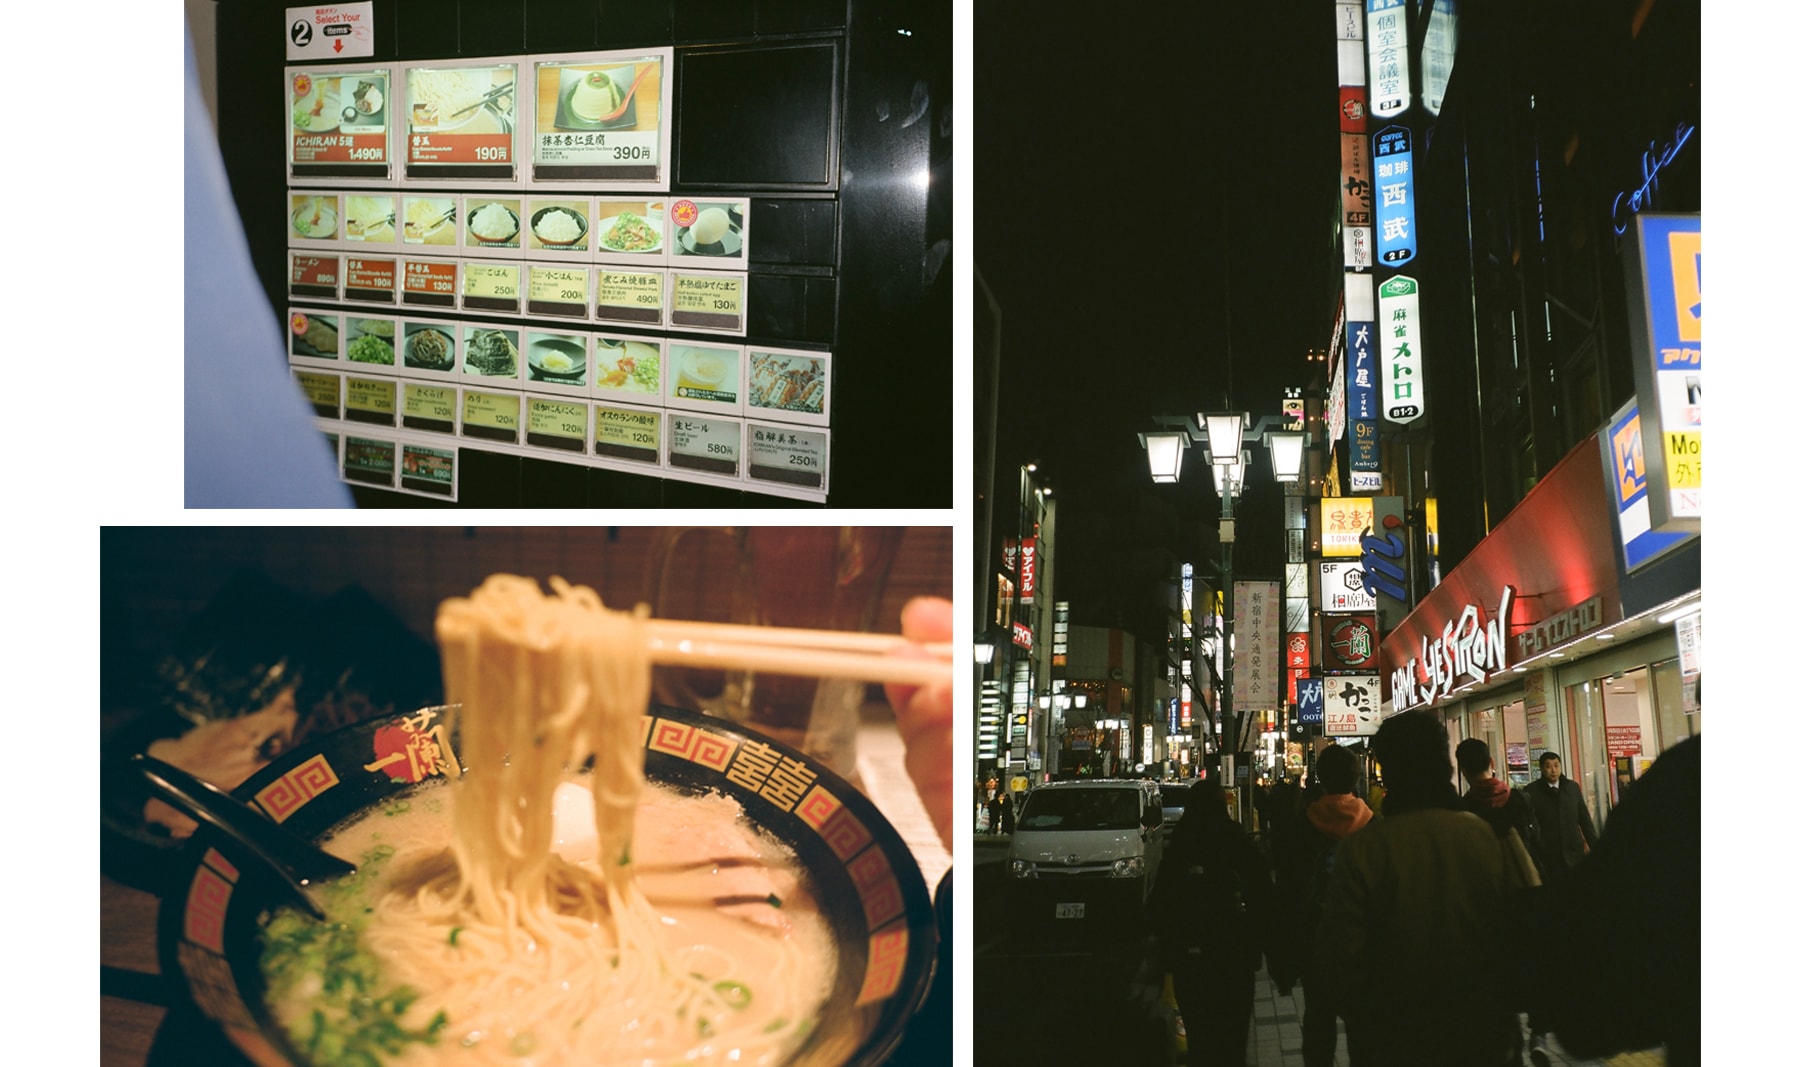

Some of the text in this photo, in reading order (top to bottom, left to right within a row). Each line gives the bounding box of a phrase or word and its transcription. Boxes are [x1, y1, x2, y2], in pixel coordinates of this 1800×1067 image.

[316, 14, 361, 24] Select Your
[295, 21, 309, 44] 2
[327, 26, 348, 35] items
[1377, 14, 1400, 96] 個室会議室
[296, 136, 337, 146] ICHIRAN
[542, 134, 606, 146] 抹茶杏仁豆腐
[348, 148, 383, 160] 1,490円
[475, 147, 507, 160] 190円
[613, 146, 651, 160] 390円
[1379, 160, 1409, 177] 珈琲
[1613, 121, 1695, 234] Coffee
[1350, 213, 1367, 222] 4F
[1382, 181, 1409, 242] 西武
[561, 290, 583, 299] 200円
[636, 295, 658, 304] 490円
[713, 300, 736, 310] 130円
[1393, 308, 1407, 338] 麻雀
[1355, 325, 1371, 388] 大戸屋
[1392, 342, 1412, 400] メトロ
[562, 423, 582, 433] 120円
[674, 421, 709, 432] 生ビール
[1356, 423, 1374, 438] 9F
[632, 433, 654, 444] 120円
[1672, 434, 1701, 454] Mo
[707, 444, 733, 455] 580円
[789, 454, 817, 467] 250円
[1676, 463, 1701, 483] 外
[1023, 556, 1033, 591] アイフル
[1322, 564, 1337, 574] 5F
[1251, 592, 1263, 694] 新宿中央通発展会
[1331, 625, 1371, 658] 一蘭
[1392, 585, 1511, 712] GAME YESTRON
[1367, 678, 1379, 686] 4F
[1339, 682, 1371, 721] かっこ
[1328, 714, 1356, 723] 江ノ島
[363, 708, 461, 782] 一蘭
